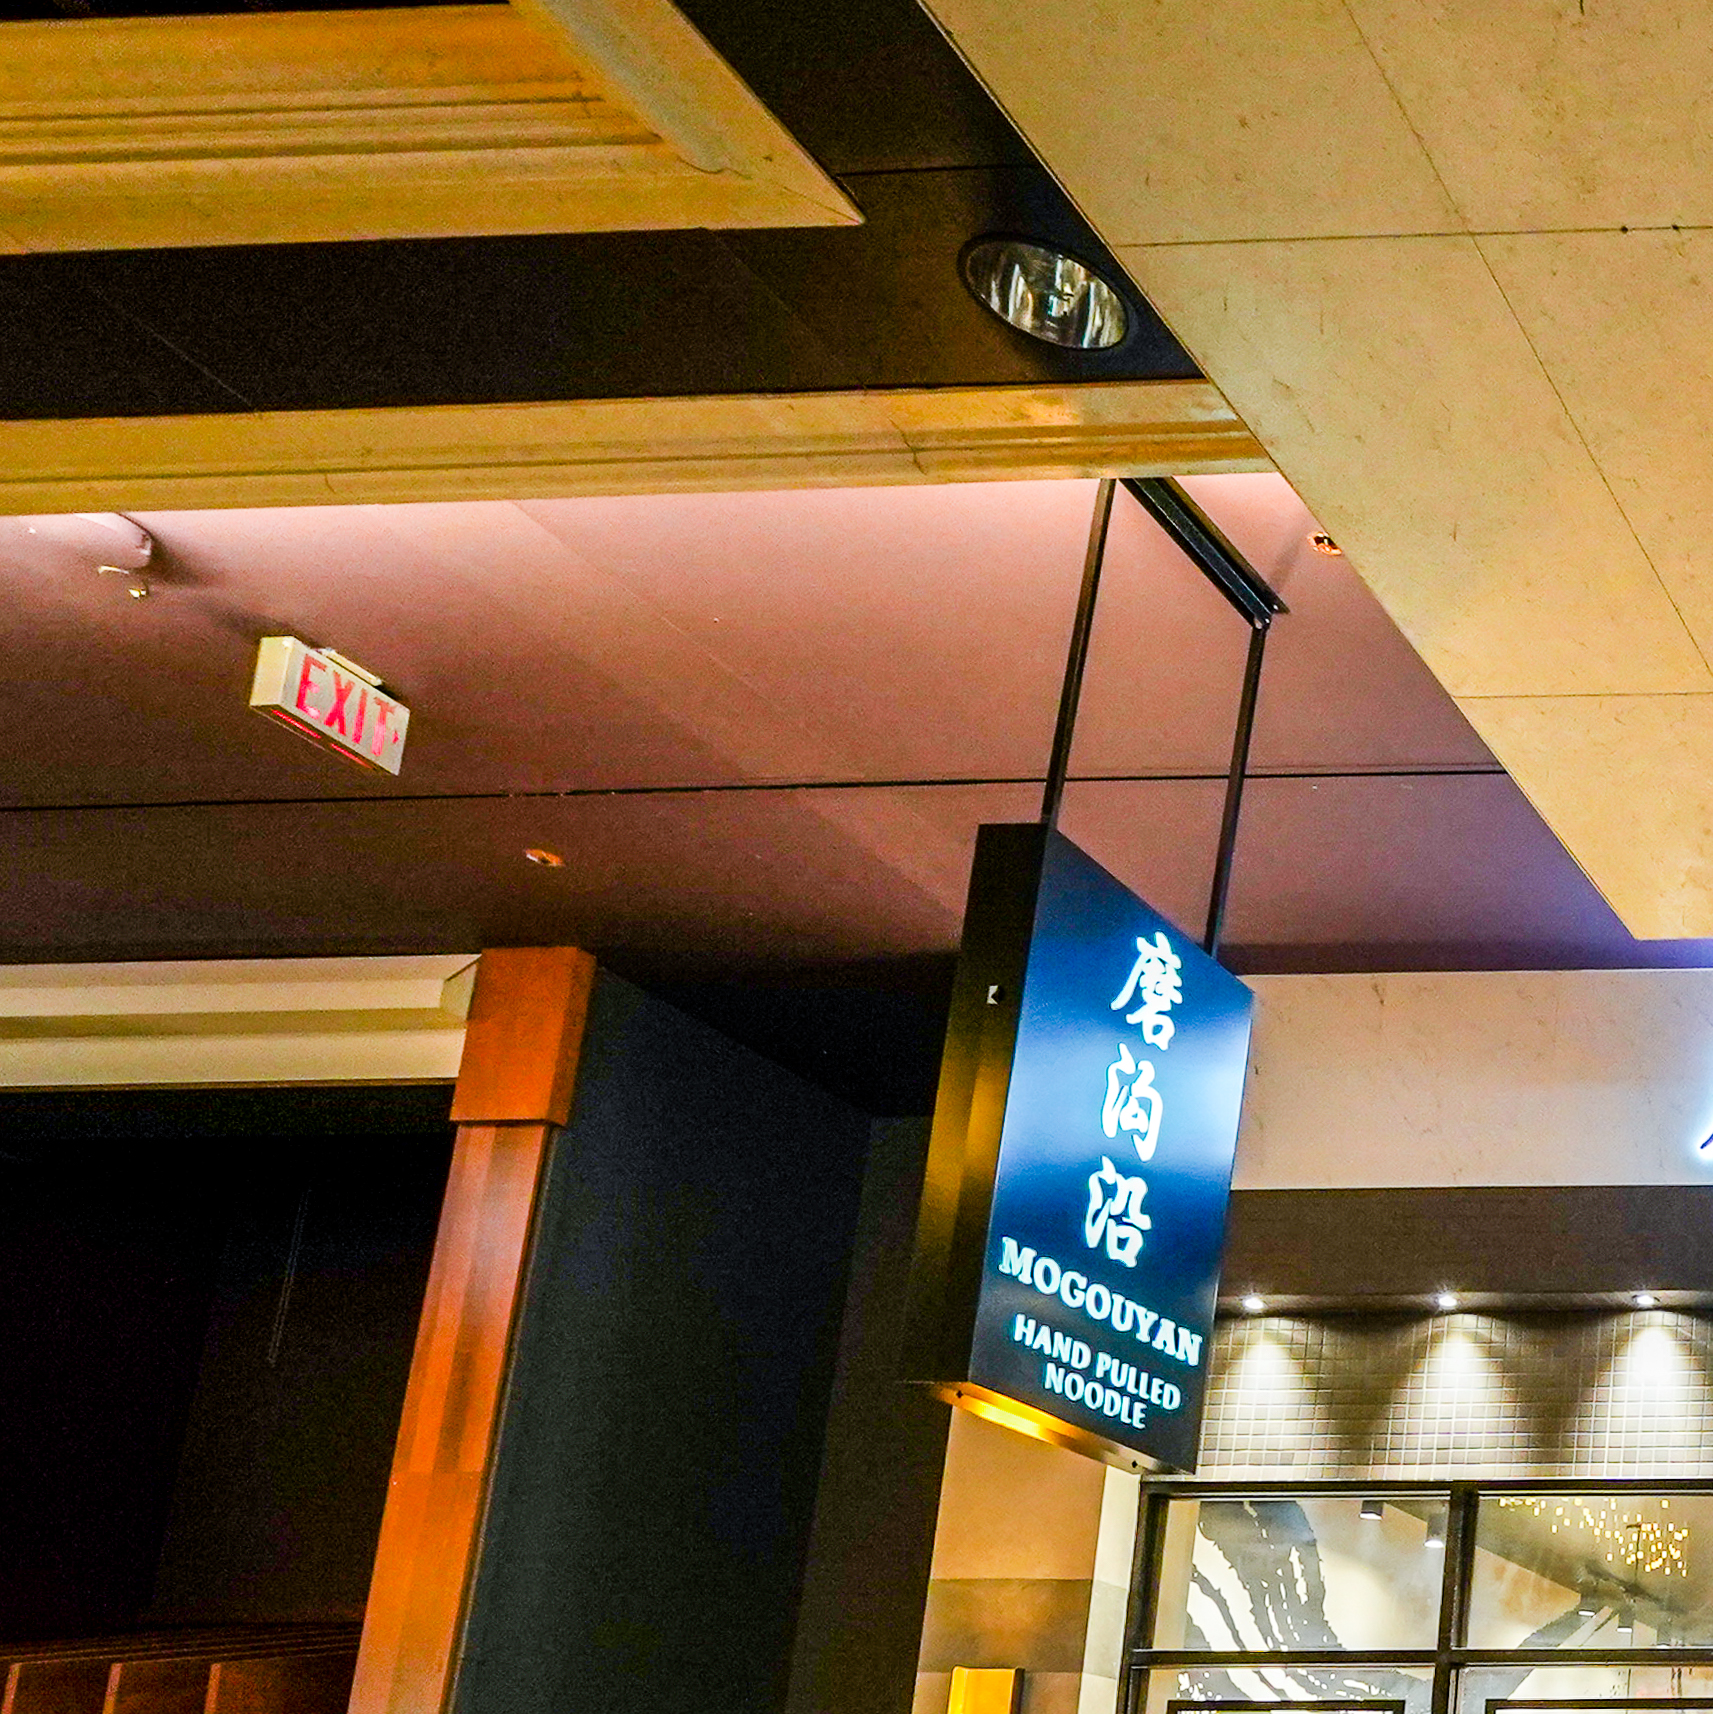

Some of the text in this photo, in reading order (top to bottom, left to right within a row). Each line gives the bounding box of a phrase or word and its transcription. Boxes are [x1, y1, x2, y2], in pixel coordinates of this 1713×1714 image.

[296, 654, 396, 757] EXIT
[999, 1237, 1202, 1366] MOGOUYAN
[1014, 1314, 1181, 1410] HAND PULLED
[1045, 1363, 1147, 1429] NOODLE
